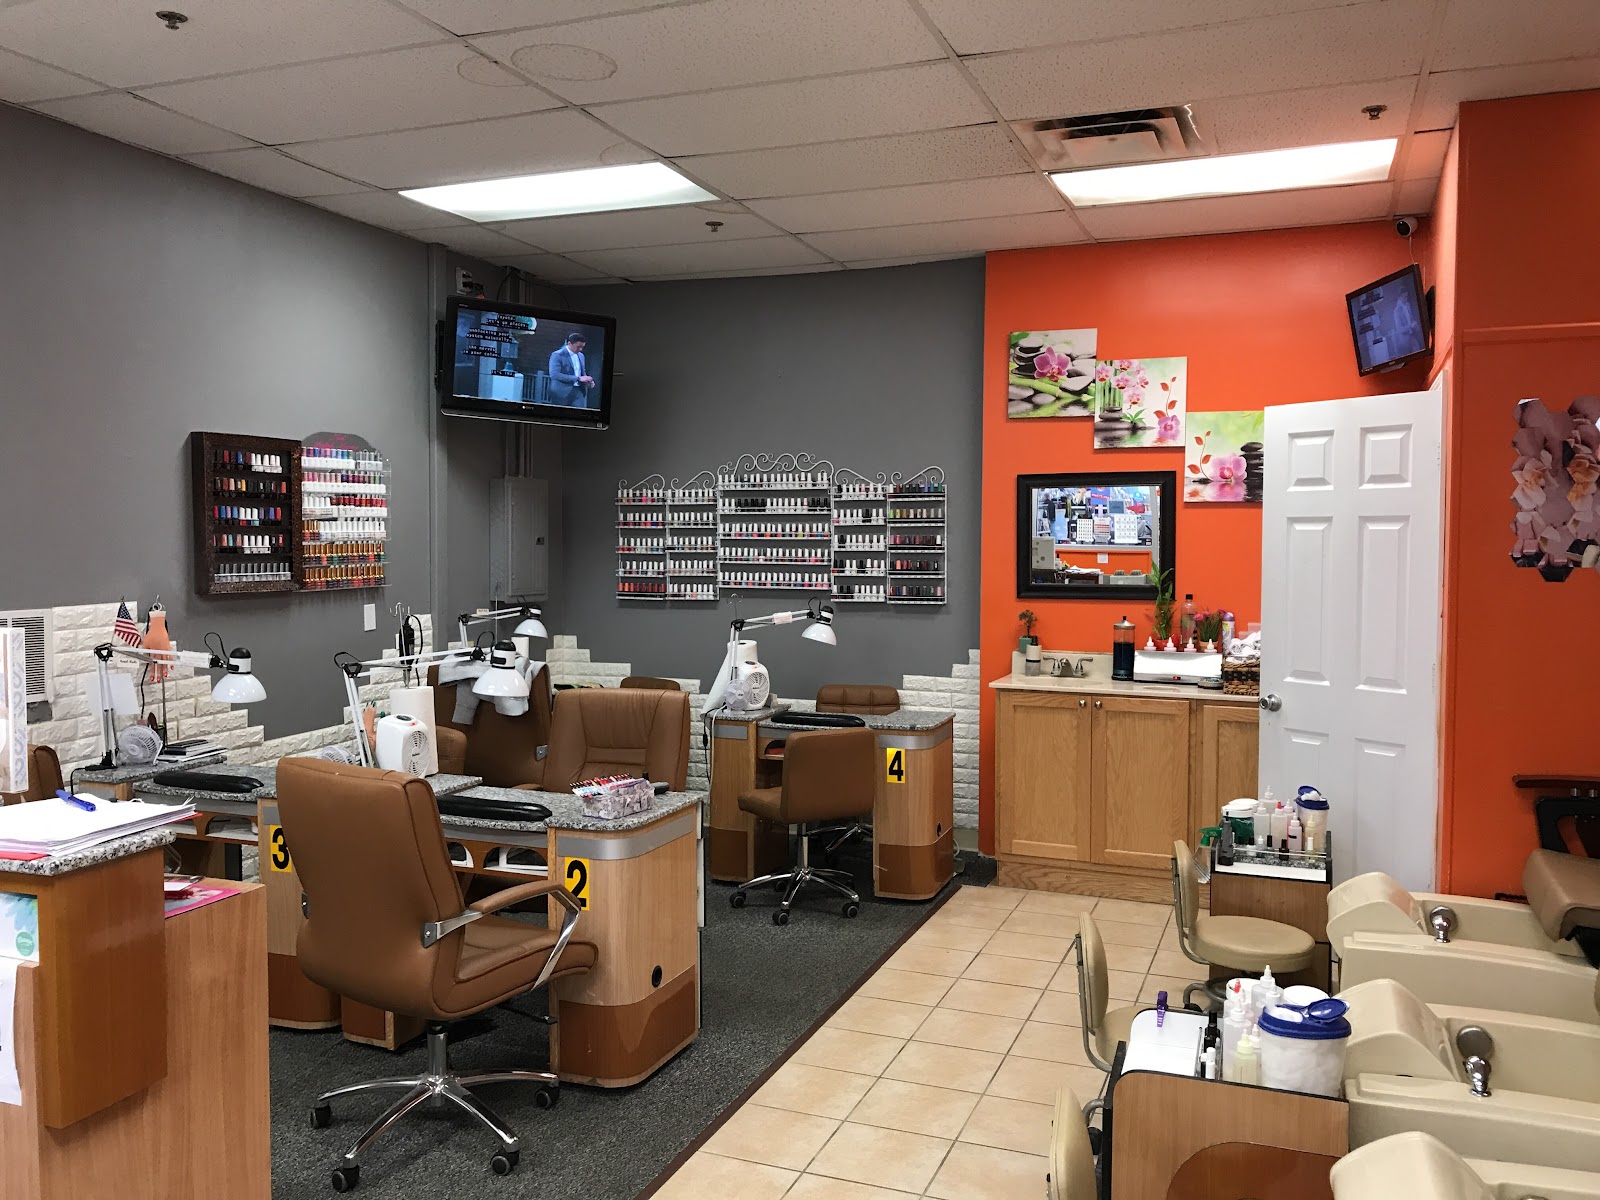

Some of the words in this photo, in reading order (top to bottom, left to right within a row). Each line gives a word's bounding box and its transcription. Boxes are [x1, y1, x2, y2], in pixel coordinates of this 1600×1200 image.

[889, 751, 904, 782] 4
[272, 827, 290, 870] 3
[567, 860, 587, 908] 2
